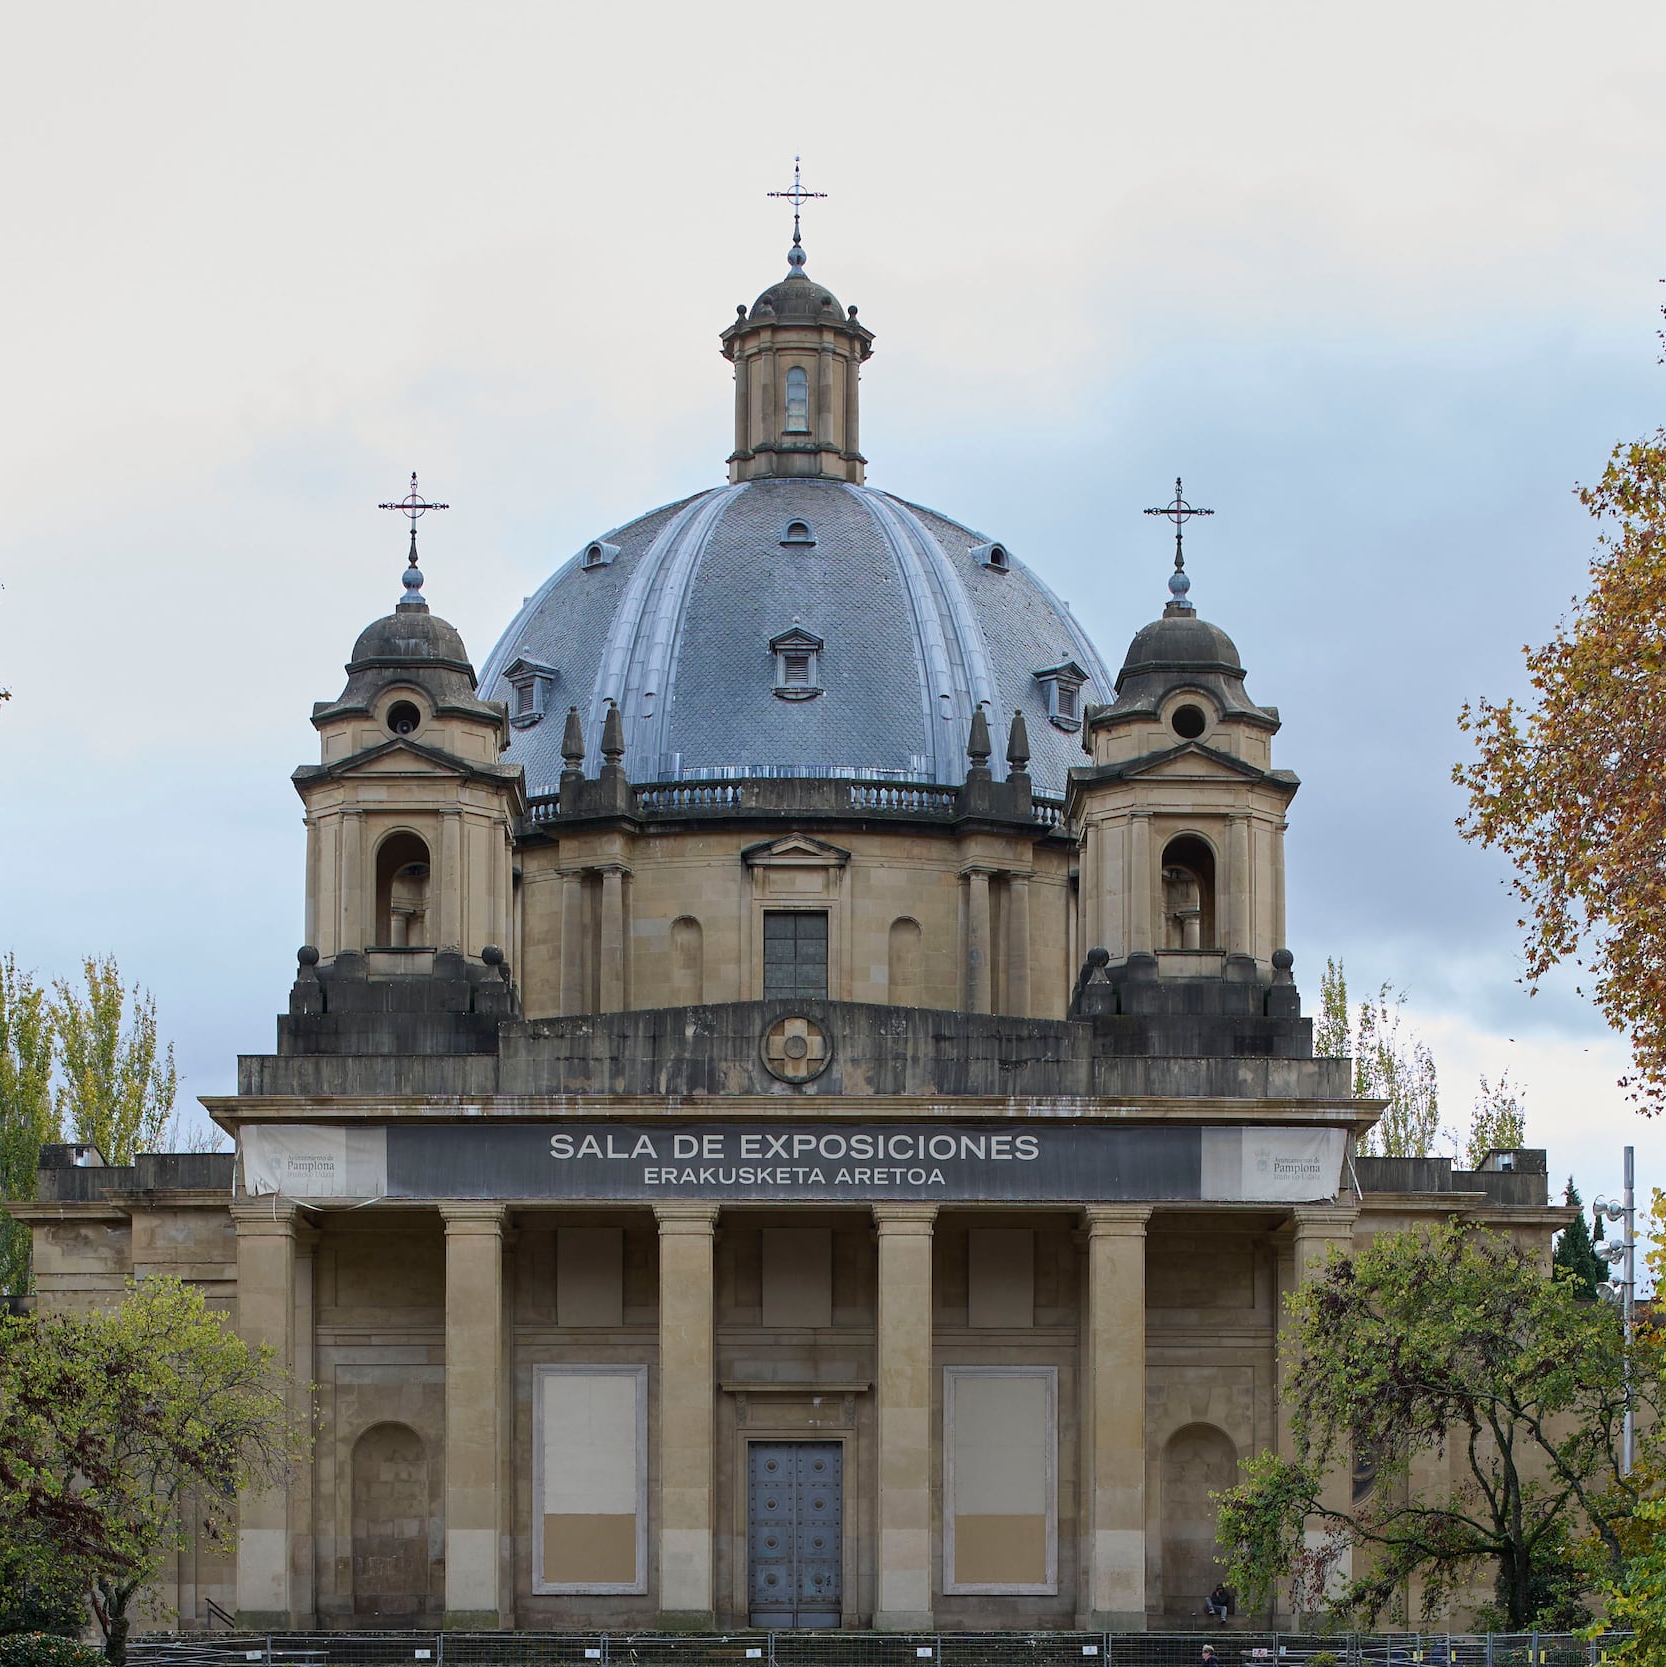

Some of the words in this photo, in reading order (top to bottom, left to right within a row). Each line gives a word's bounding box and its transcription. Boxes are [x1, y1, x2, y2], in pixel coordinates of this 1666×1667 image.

[549, 1134, 658, 1159] SALA
[673, 1134, 725, 1159] DE
[740, 1134, 1040, 1160] EXPOSICIONES
[287, 1161, 335, 1172] Pamplona
[1274, 1163, 1320, 1175] Pamplona
[644, 1167, 826, 1184] ERAKUSKETA
[834, 1167, 946, 1185] ARETOA
